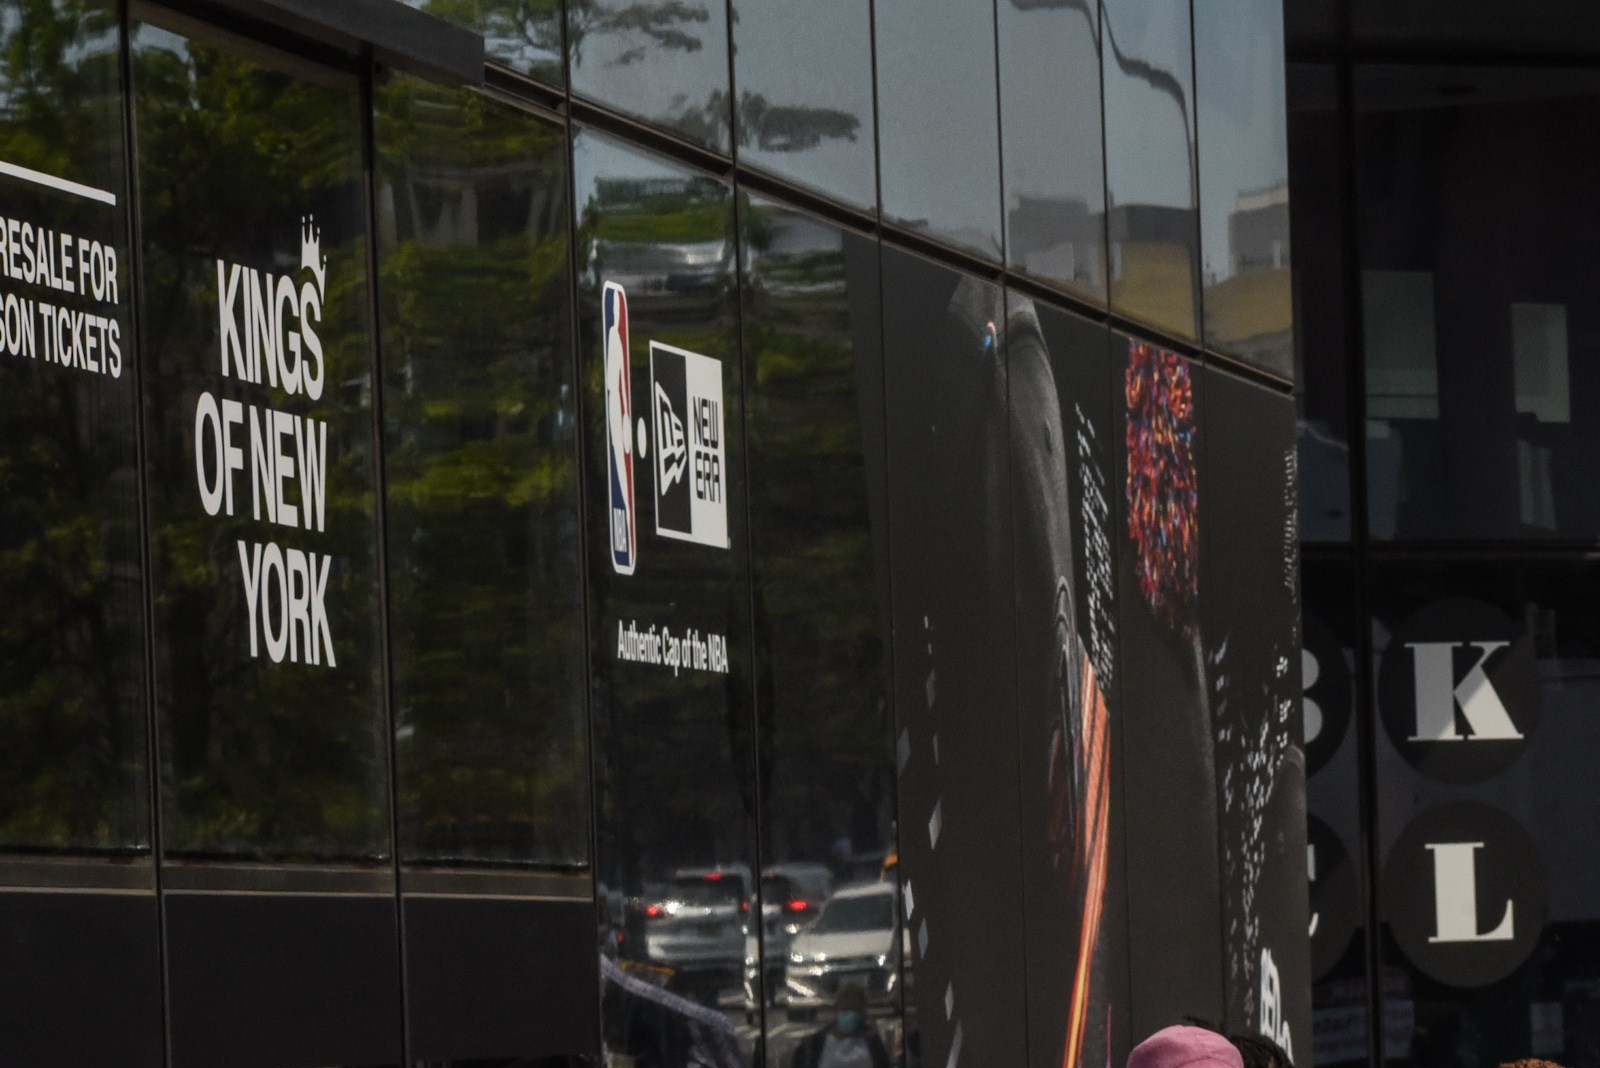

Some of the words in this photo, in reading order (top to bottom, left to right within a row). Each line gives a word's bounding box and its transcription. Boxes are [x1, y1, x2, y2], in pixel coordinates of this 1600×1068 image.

[78, 238, 119, 305] FOR
[39, 302, 122, 379] TICKETS
[217, 259, 325, 401] KINGS
[692, 395, 719, 450] NEW
[195, 391, 244, 517] OF
[249, 405, 327, 533] NEW
[695, 450, 721, 504] ERA
[237, 539, 336, 668] YORK
[617, 619, 661, 665] Authentic
[662, 626, 681, 677] Cap
[681, 627, 691, 668] of
[692, 629, 707, 671] the
[707, 633, 729, 674] NBA
